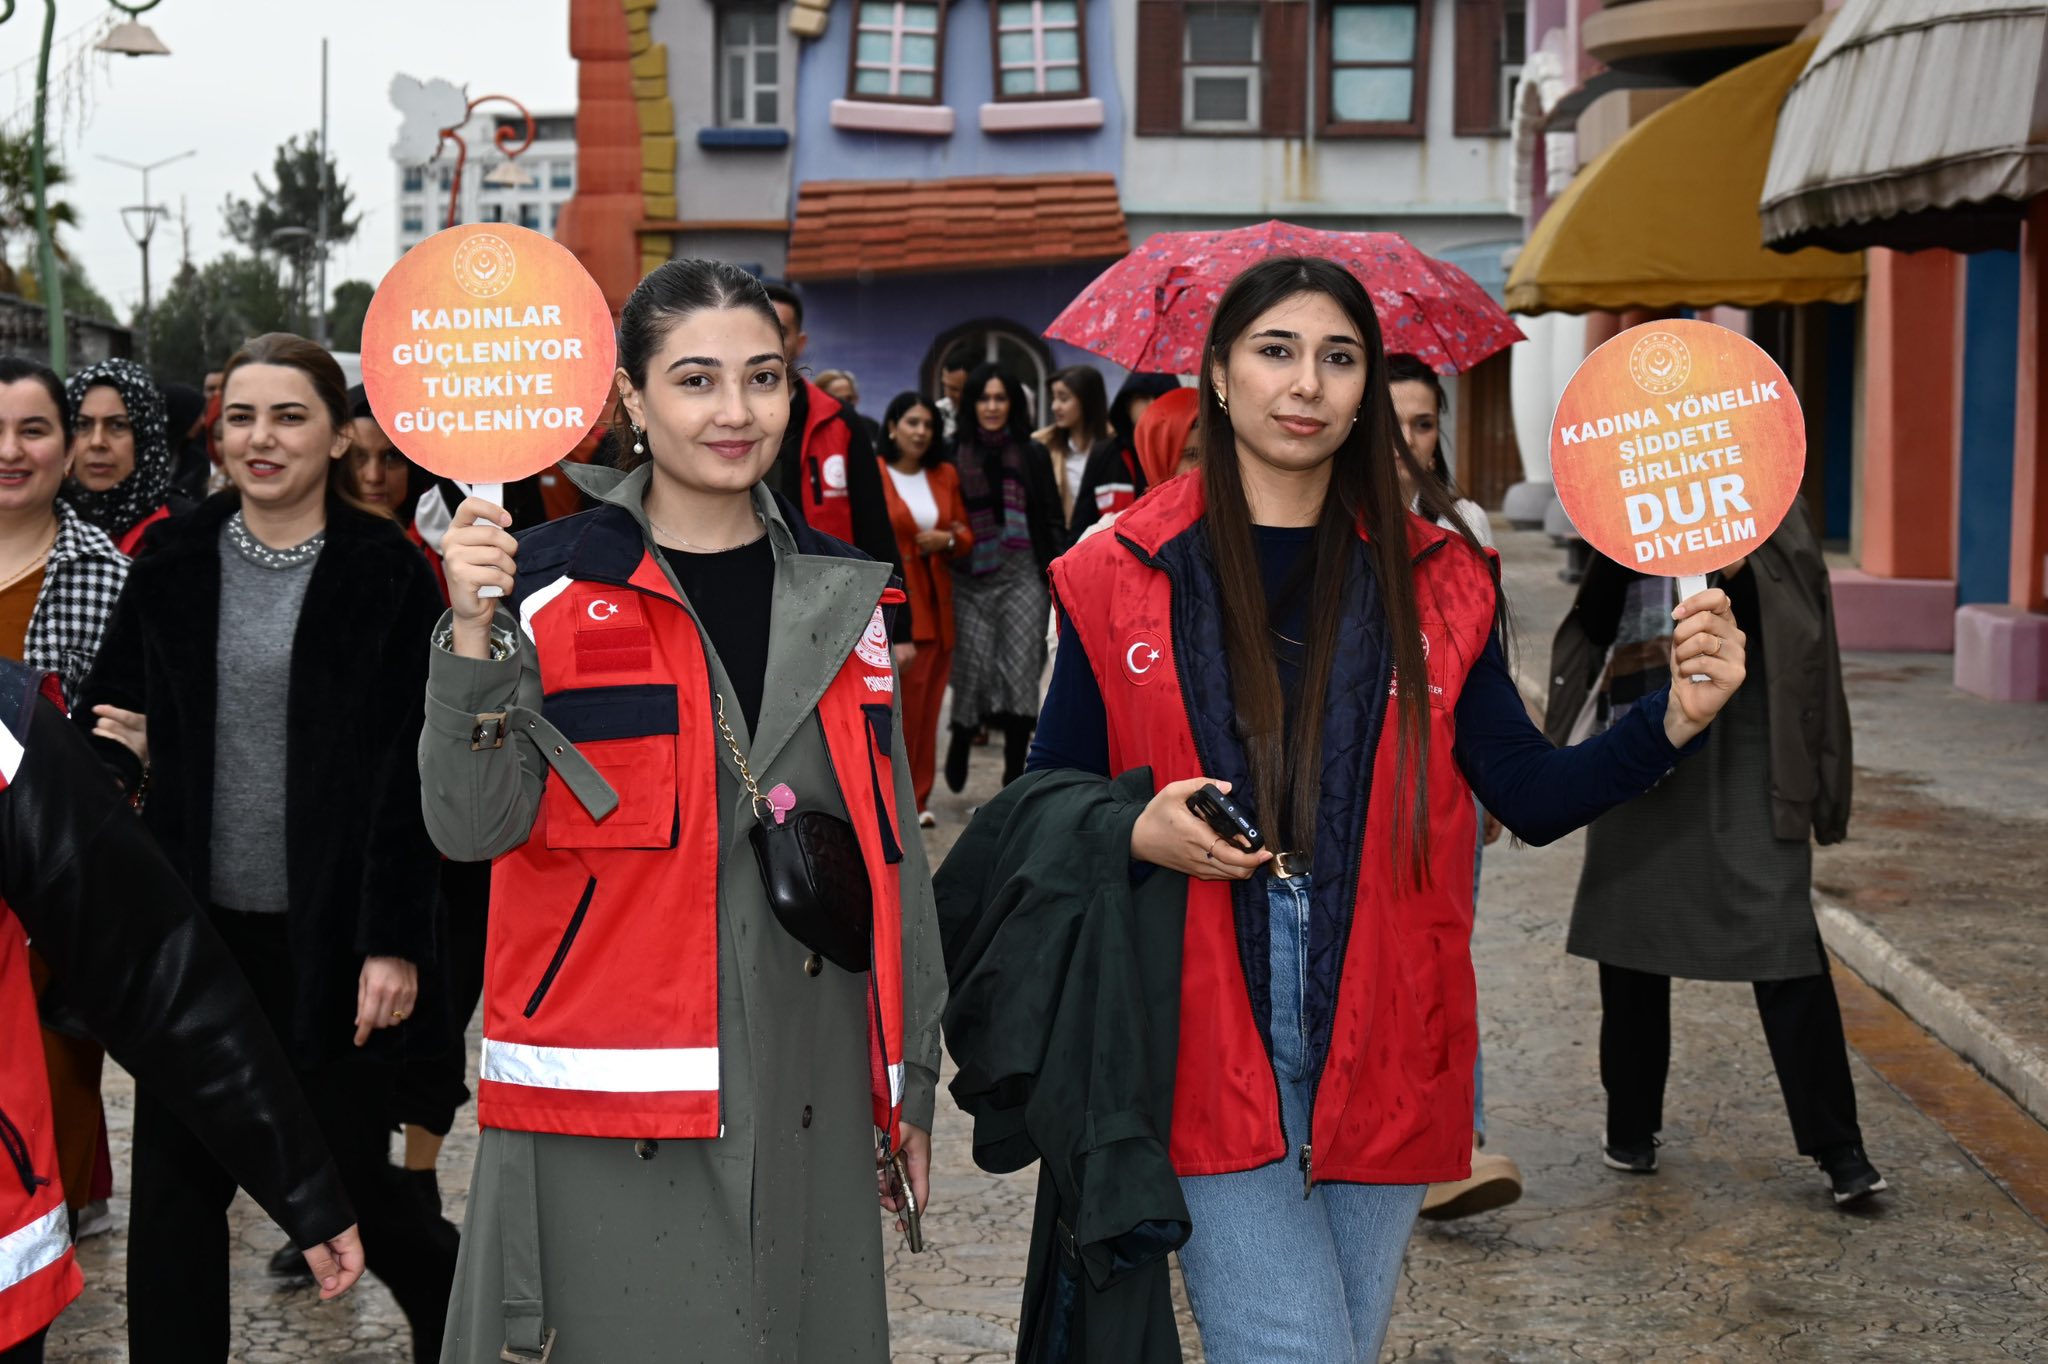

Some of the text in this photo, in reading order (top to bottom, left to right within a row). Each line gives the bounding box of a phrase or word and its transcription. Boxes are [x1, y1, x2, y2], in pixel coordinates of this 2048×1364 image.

[411, 305, 561, 330] KADINLAR
[392, 336, 583, 368] GÜÇLENİYOR
[422, 370, 552, 398] TÜRKİYE
[394, 404, 584, 437] GÜÇLENİYOR
[1560, 380, 1780, 446] KADINA YÖNELİK
[1619, 419, 1732, 464] ŞİDDETE
[1619, 445, 1743, 489] BİRLİKTE
[1625, 473, 1752, 536] DUR
[1635, 517, 1757, 563] DİYELİM
